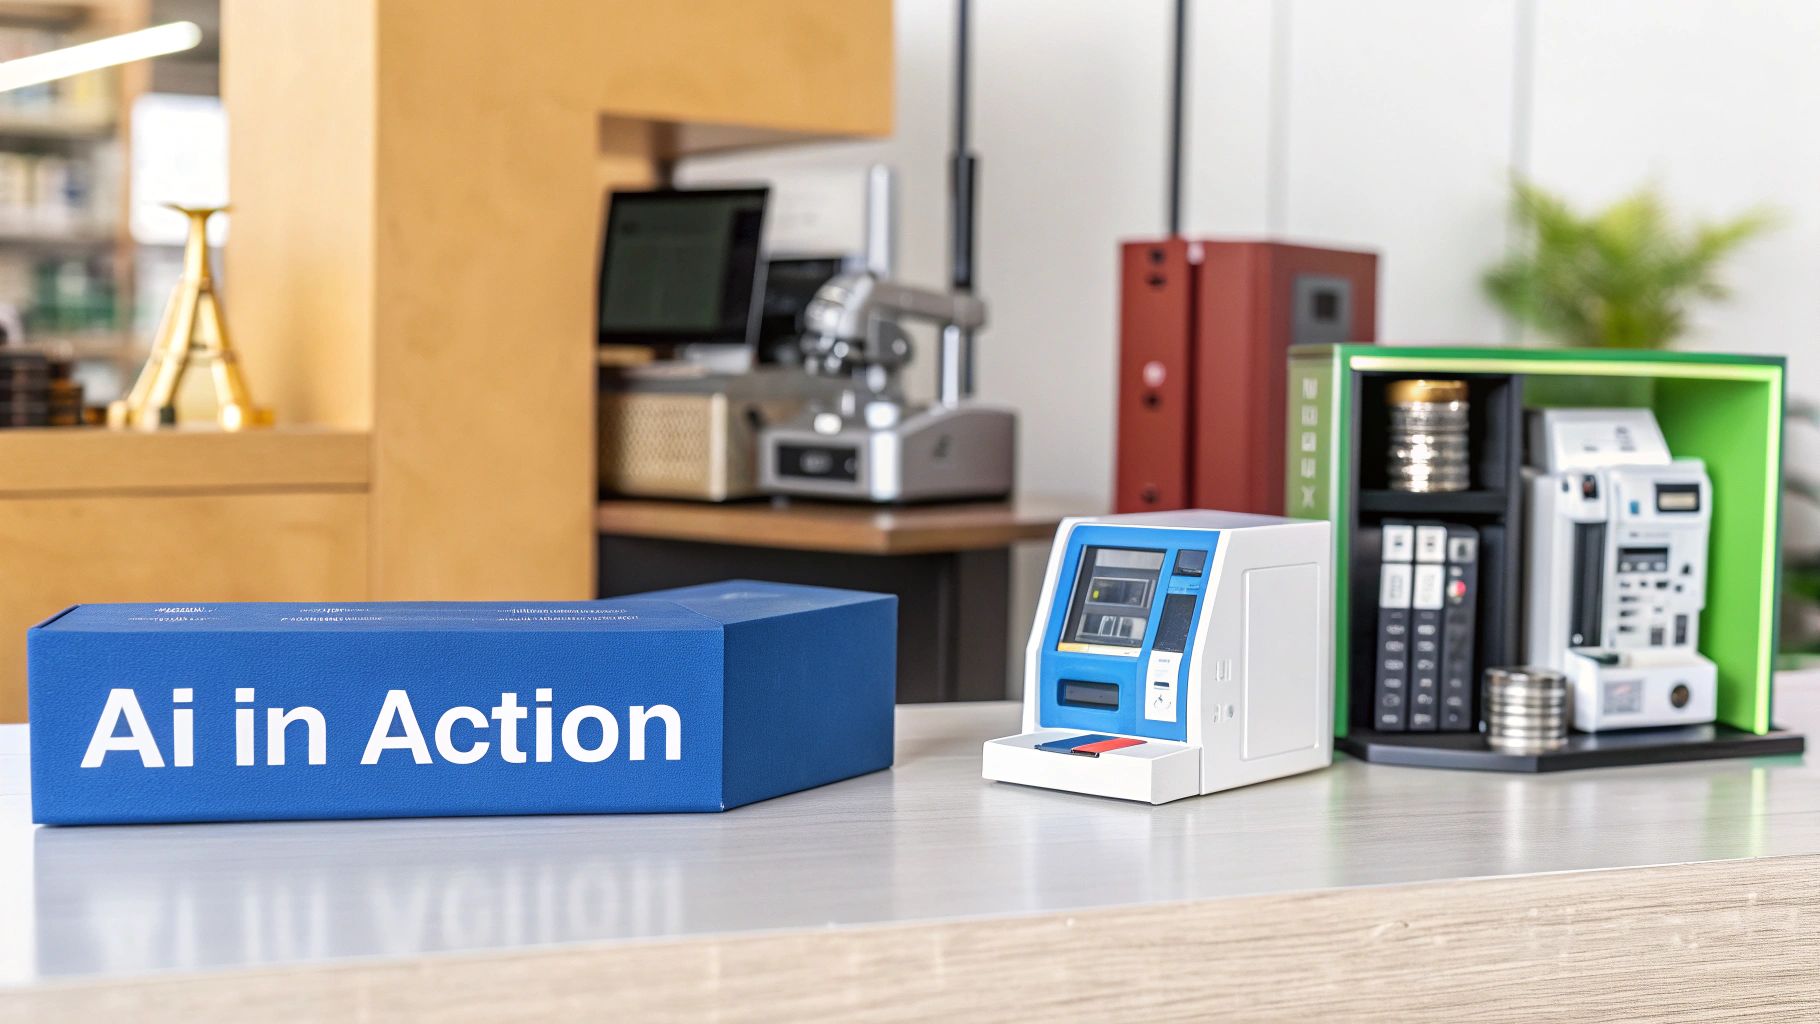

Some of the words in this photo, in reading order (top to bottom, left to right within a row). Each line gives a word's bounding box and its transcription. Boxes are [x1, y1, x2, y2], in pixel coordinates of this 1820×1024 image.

[81, 688, 194, 768] Ai
[236, 688, 327, 766] in
[360, 688, 682, 764] Action
